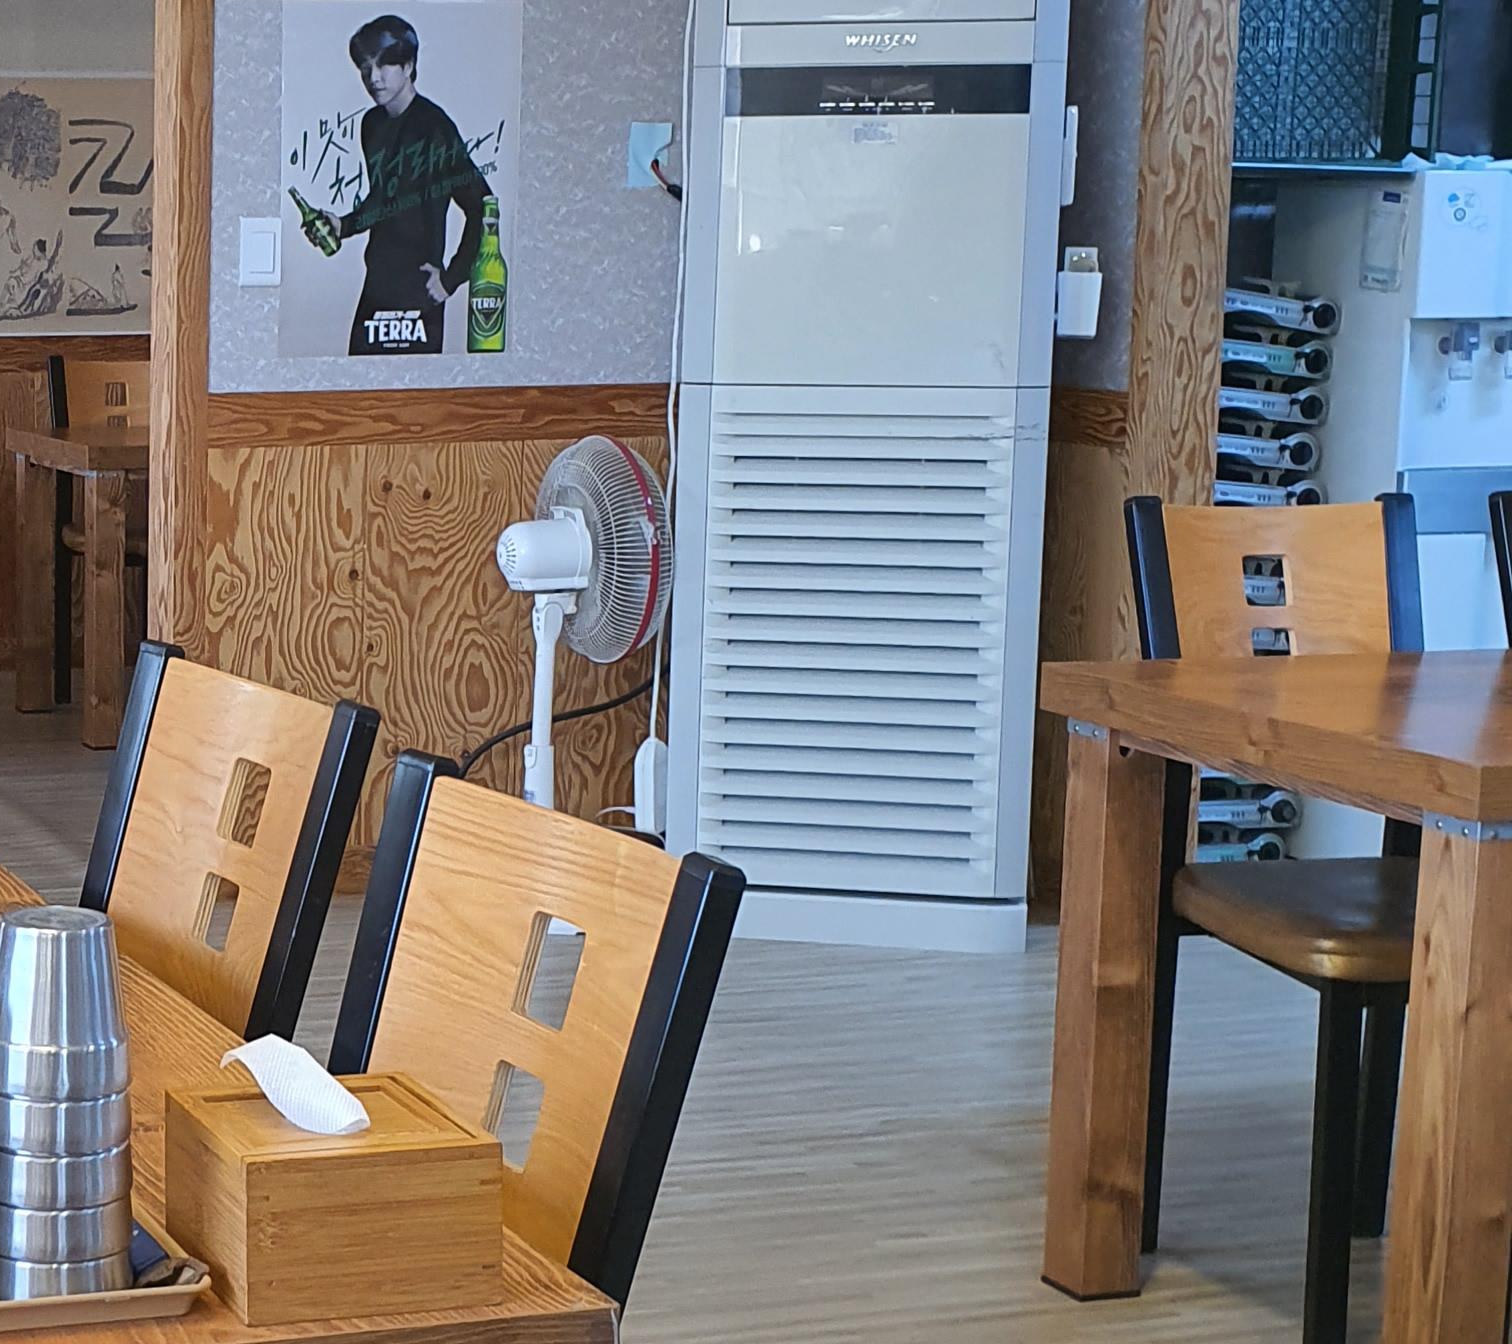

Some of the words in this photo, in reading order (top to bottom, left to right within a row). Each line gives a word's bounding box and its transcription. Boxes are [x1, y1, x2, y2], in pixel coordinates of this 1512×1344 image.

[844, 33, 918, 50] WHISEN
[290, 130, 309, 171] 이
[470, 296, 502, 311] TERRA
[364, 319, 428, 344] TERRA
